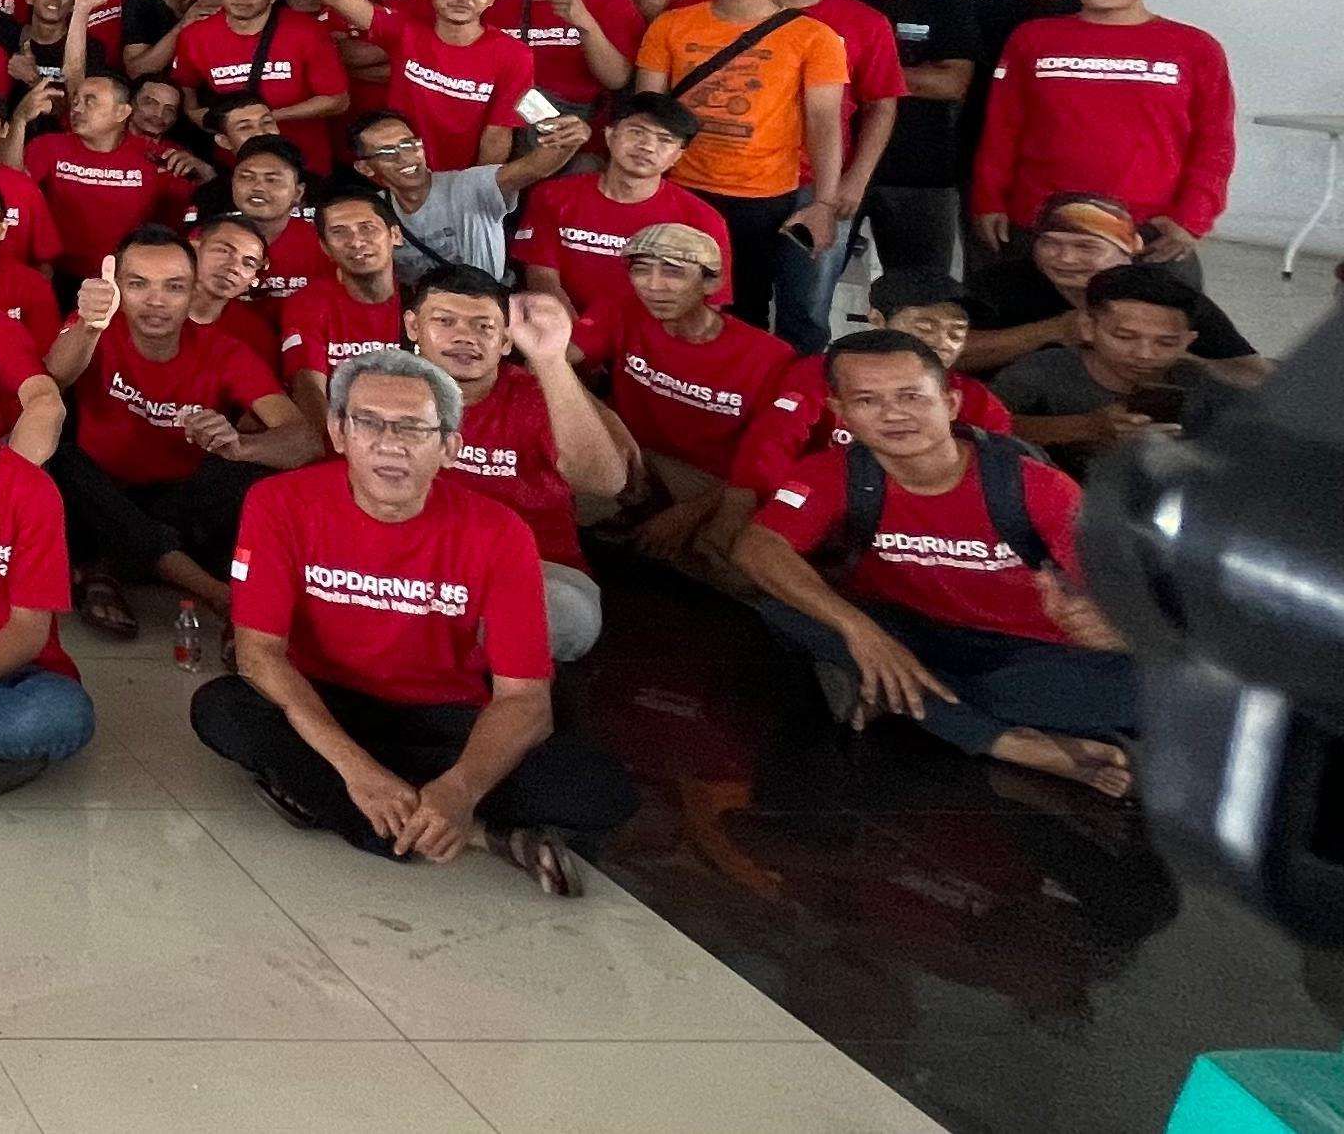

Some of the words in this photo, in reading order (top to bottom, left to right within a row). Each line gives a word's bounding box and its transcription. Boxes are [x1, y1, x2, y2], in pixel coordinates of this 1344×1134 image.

[558, 227, 628, 249] KOPDARN
[716, 391, 743, 408] #6
[491, 449, 518, 466] #6
[873, 533, 990, 559] PDARNAS
[304, 565, 436, 601] KOPDARNAS
[441, 583, 469, 604] #6
